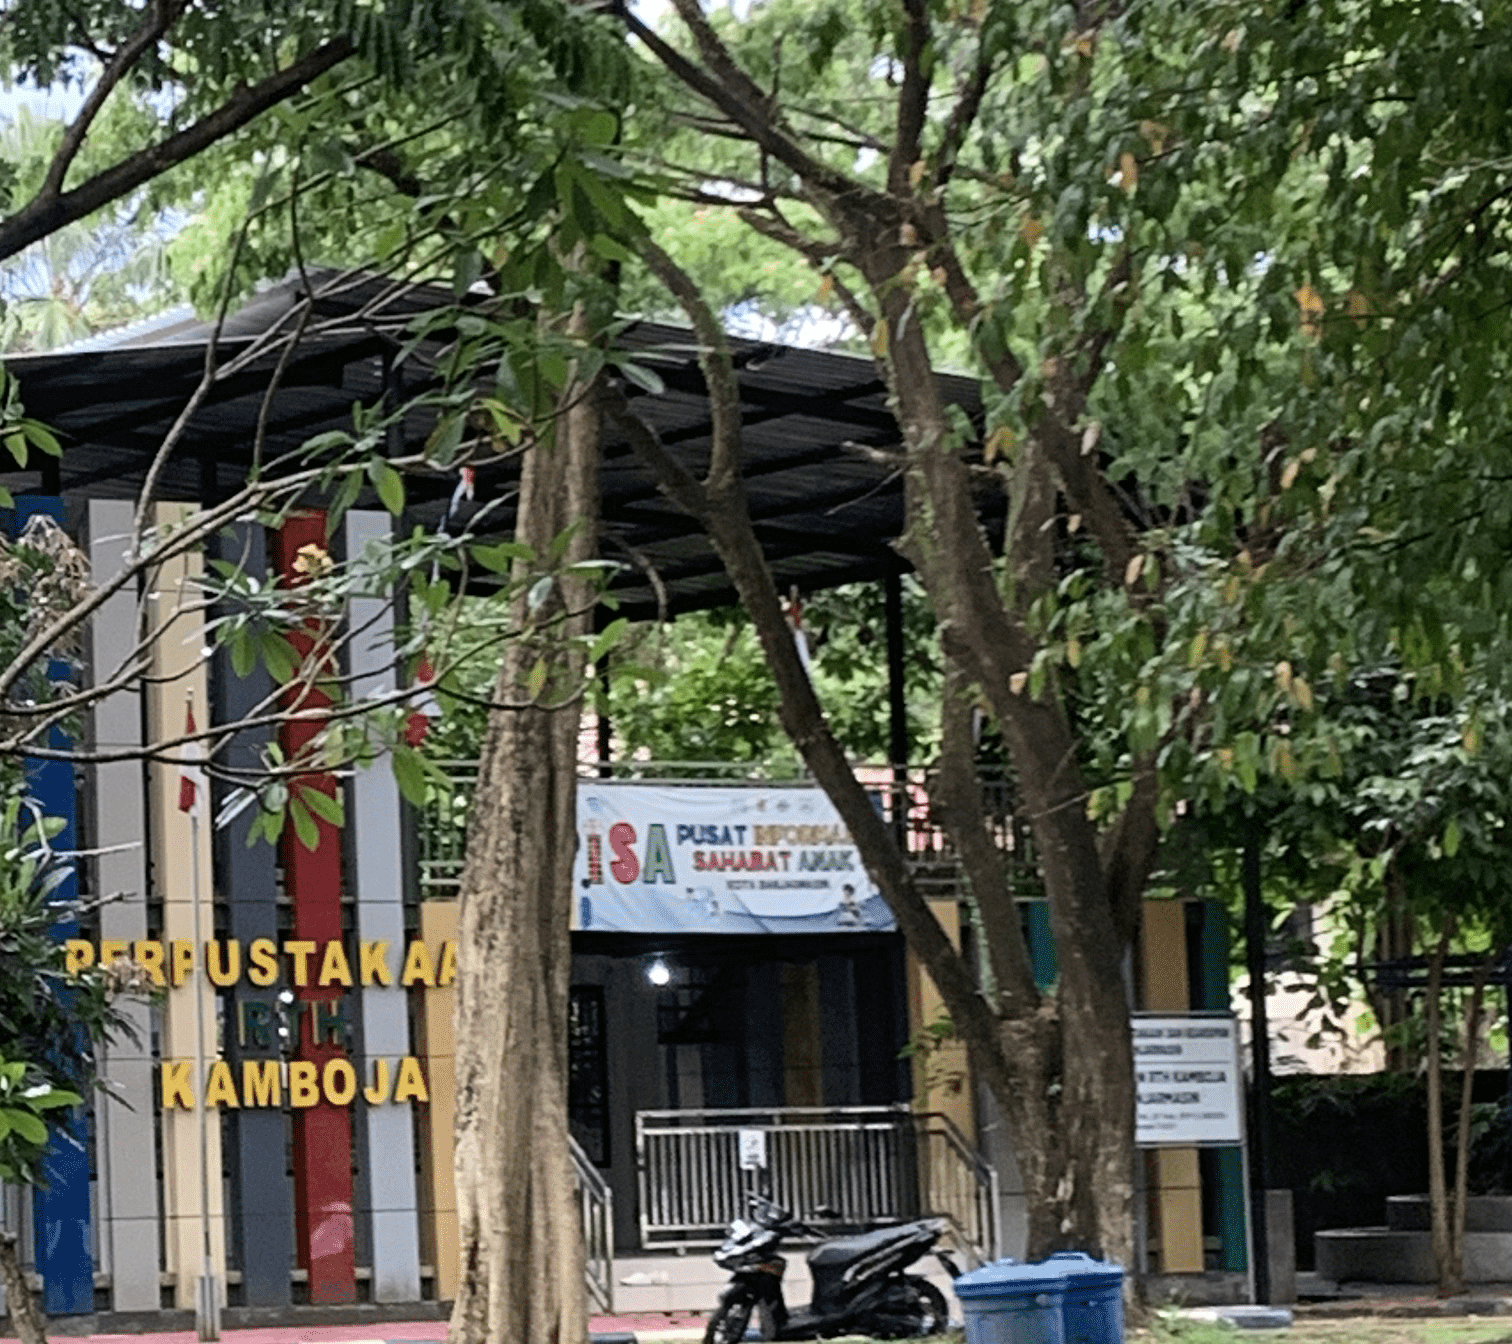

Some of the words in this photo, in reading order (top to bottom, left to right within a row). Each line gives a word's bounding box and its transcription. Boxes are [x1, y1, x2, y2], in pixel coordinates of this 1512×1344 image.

[676, 824, 747, 846] PUSAT
[693, 850, 791, 872] SAHABAT
[64, 938, 458, 988] PERPUSTAKAA
[161, 1057, 430, 1109] KAMBOJA
